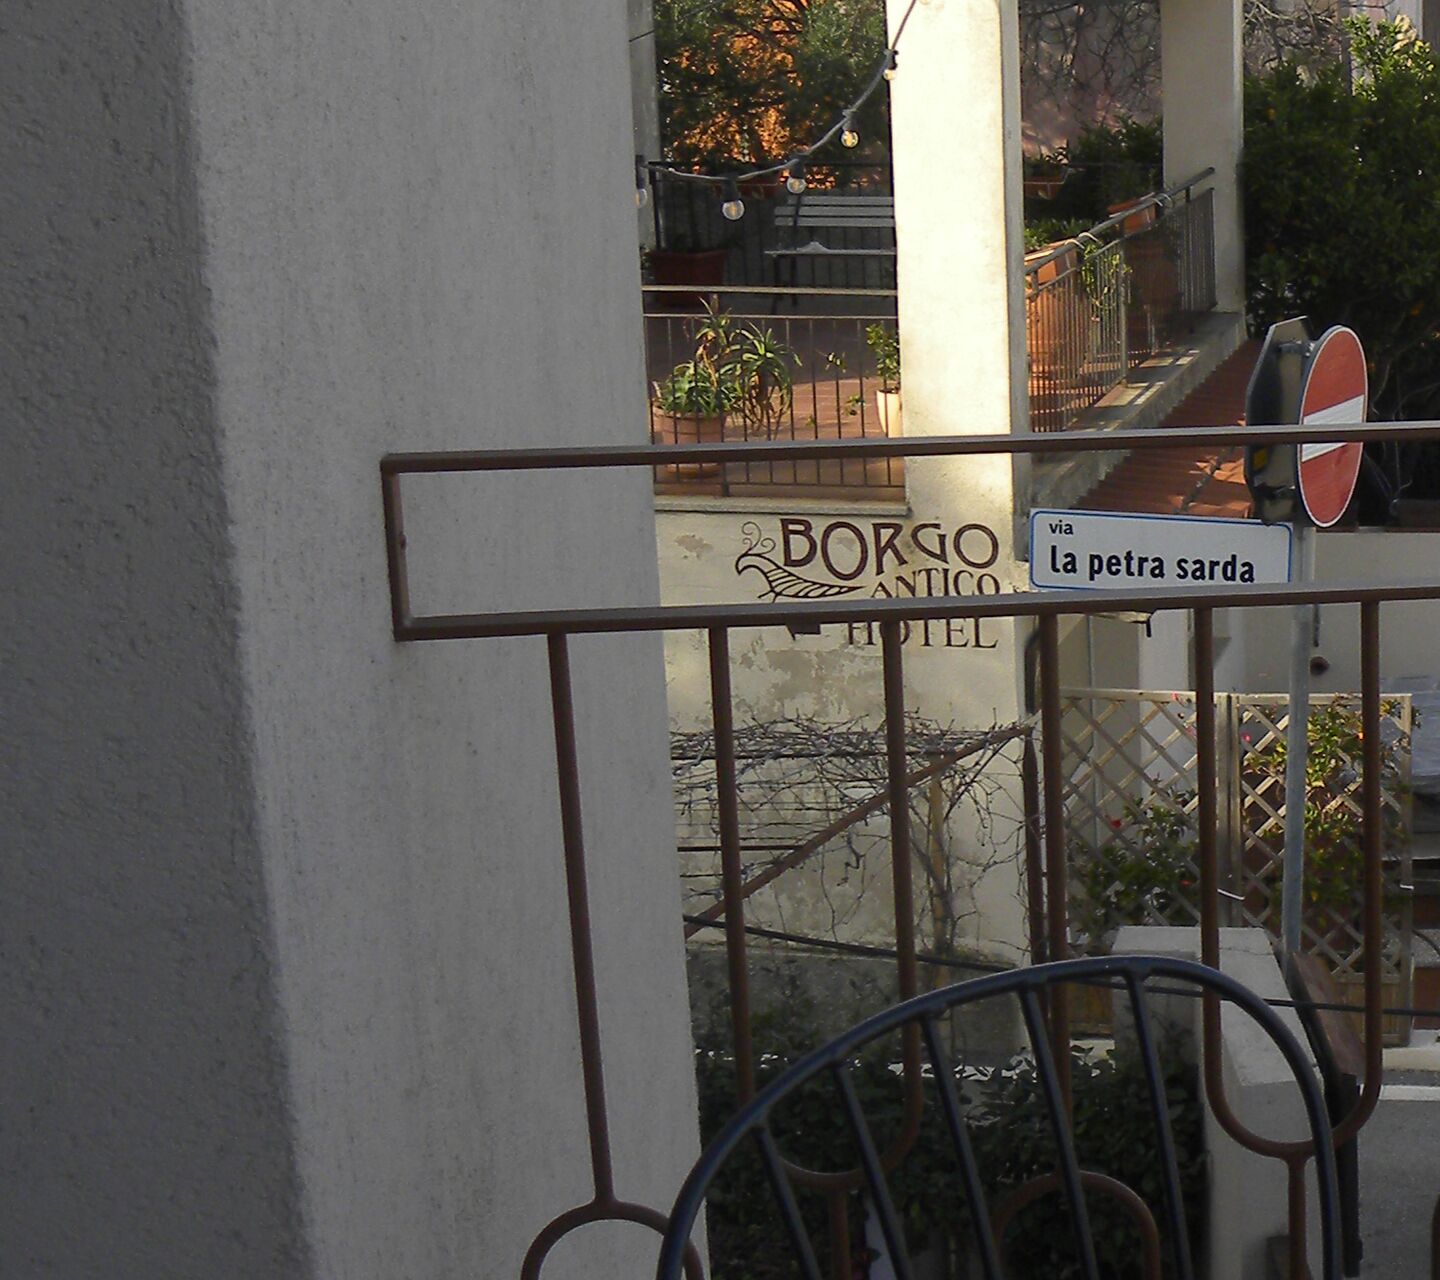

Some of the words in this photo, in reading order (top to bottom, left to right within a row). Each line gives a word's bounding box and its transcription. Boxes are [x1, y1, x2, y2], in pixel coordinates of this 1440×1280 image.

[1049, 519, 1074, 535] via
[780, 518, 999, 581] BORGO
[1050, 545, 1077, 573] la
[1089, 550, 1165, 581] petra
[1176, 554, 1255, 583] sarda
[870, 568, 1001, 598] ANTICO
